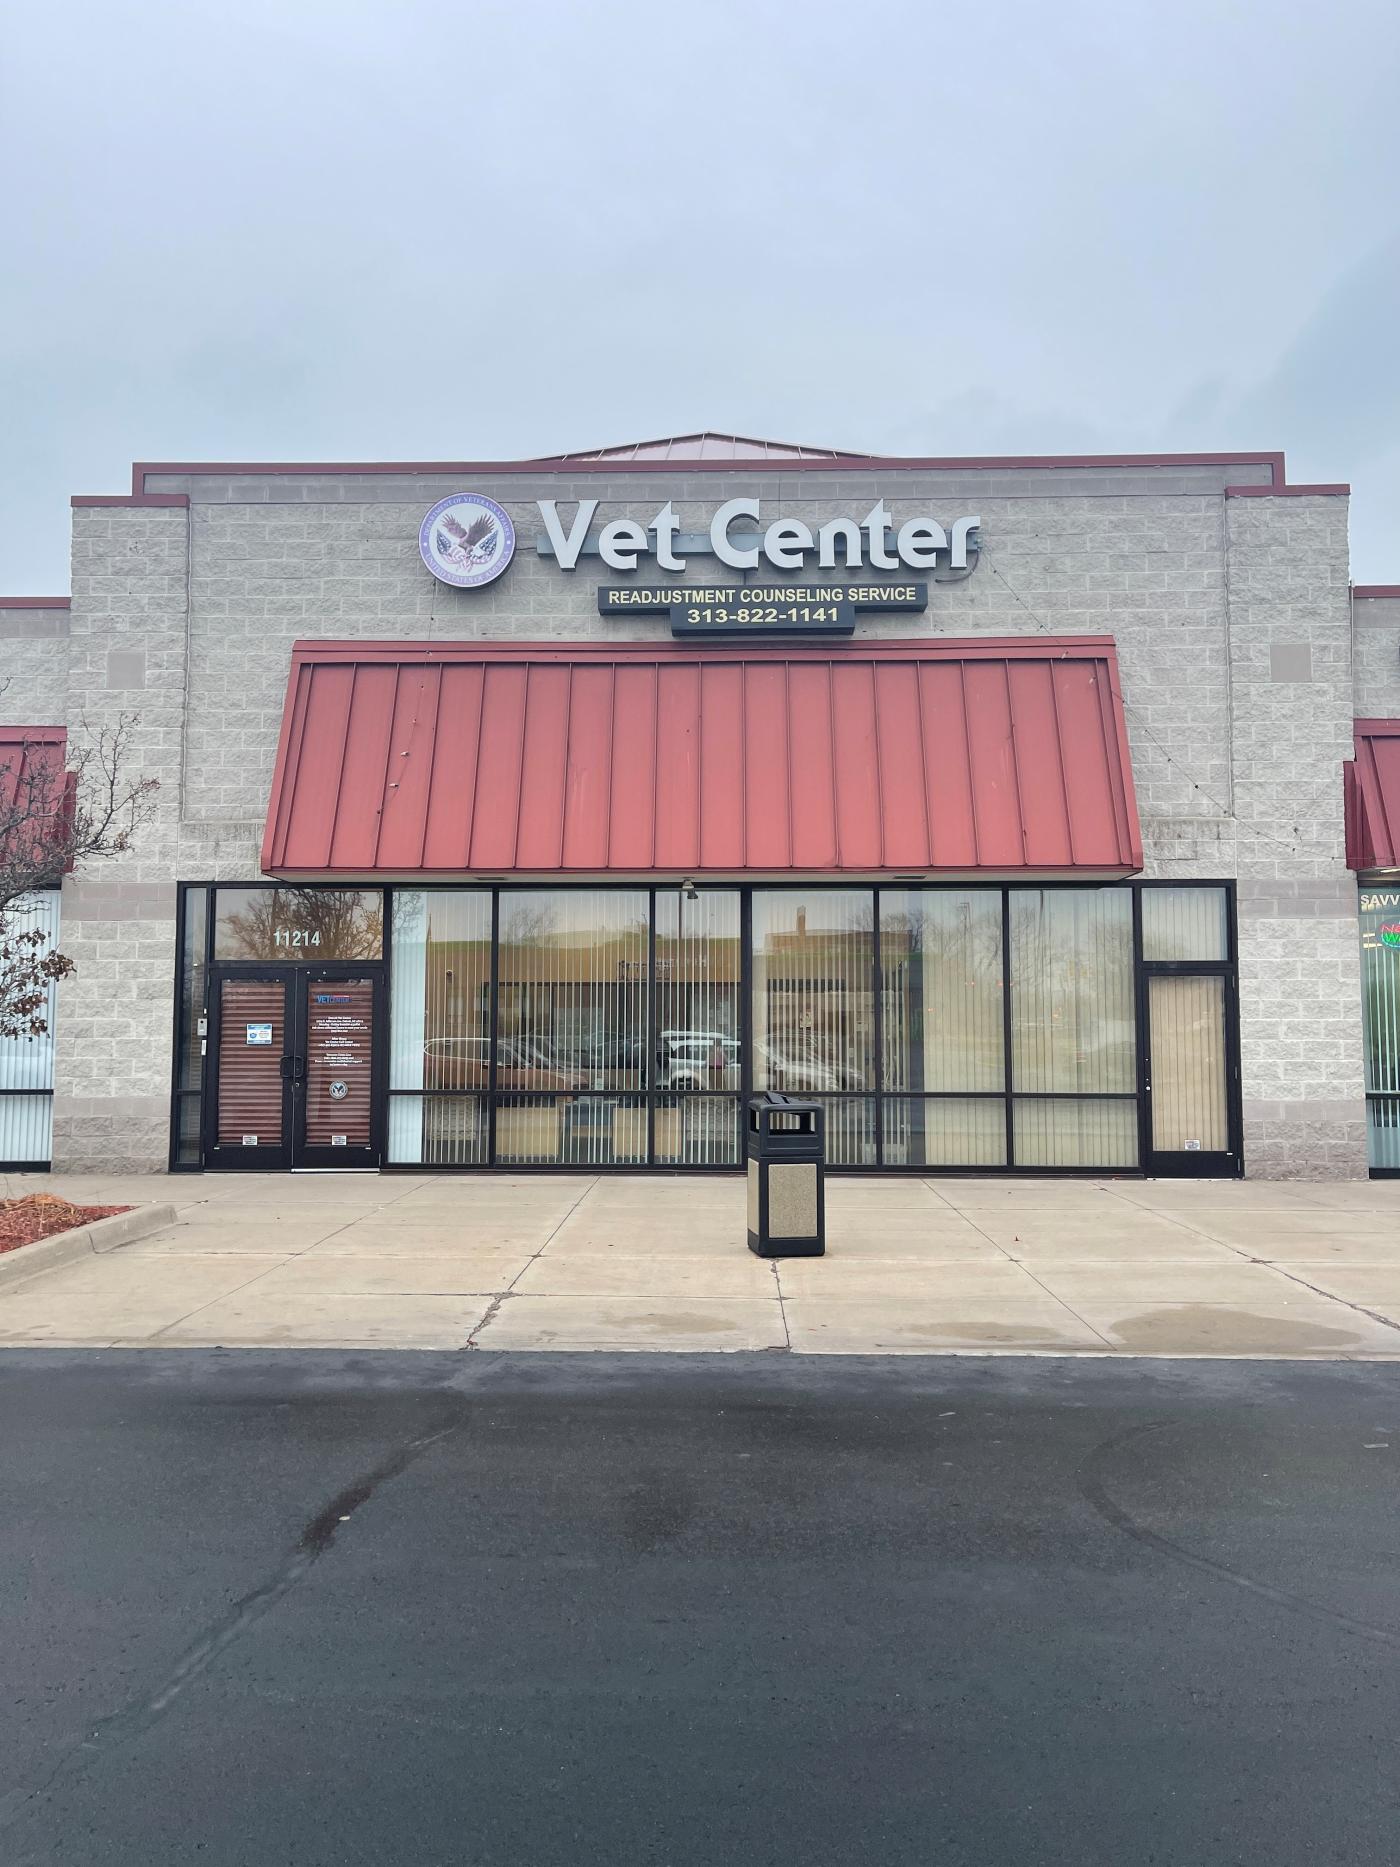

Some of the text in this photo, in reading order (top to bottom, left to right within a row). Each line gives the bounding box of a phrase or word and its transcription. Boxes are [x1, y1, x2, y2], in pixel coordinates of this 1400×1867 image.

[537, 498, 981, 571] Vet Center
[608, 587, 916, 604] READJUSTMENT COUNSELING SERVICE
[687, 608, 839, 623] 313-822-1141
[1360, 894, 1400, 906] SAVV
[273, 930, 321, 947] 11214
